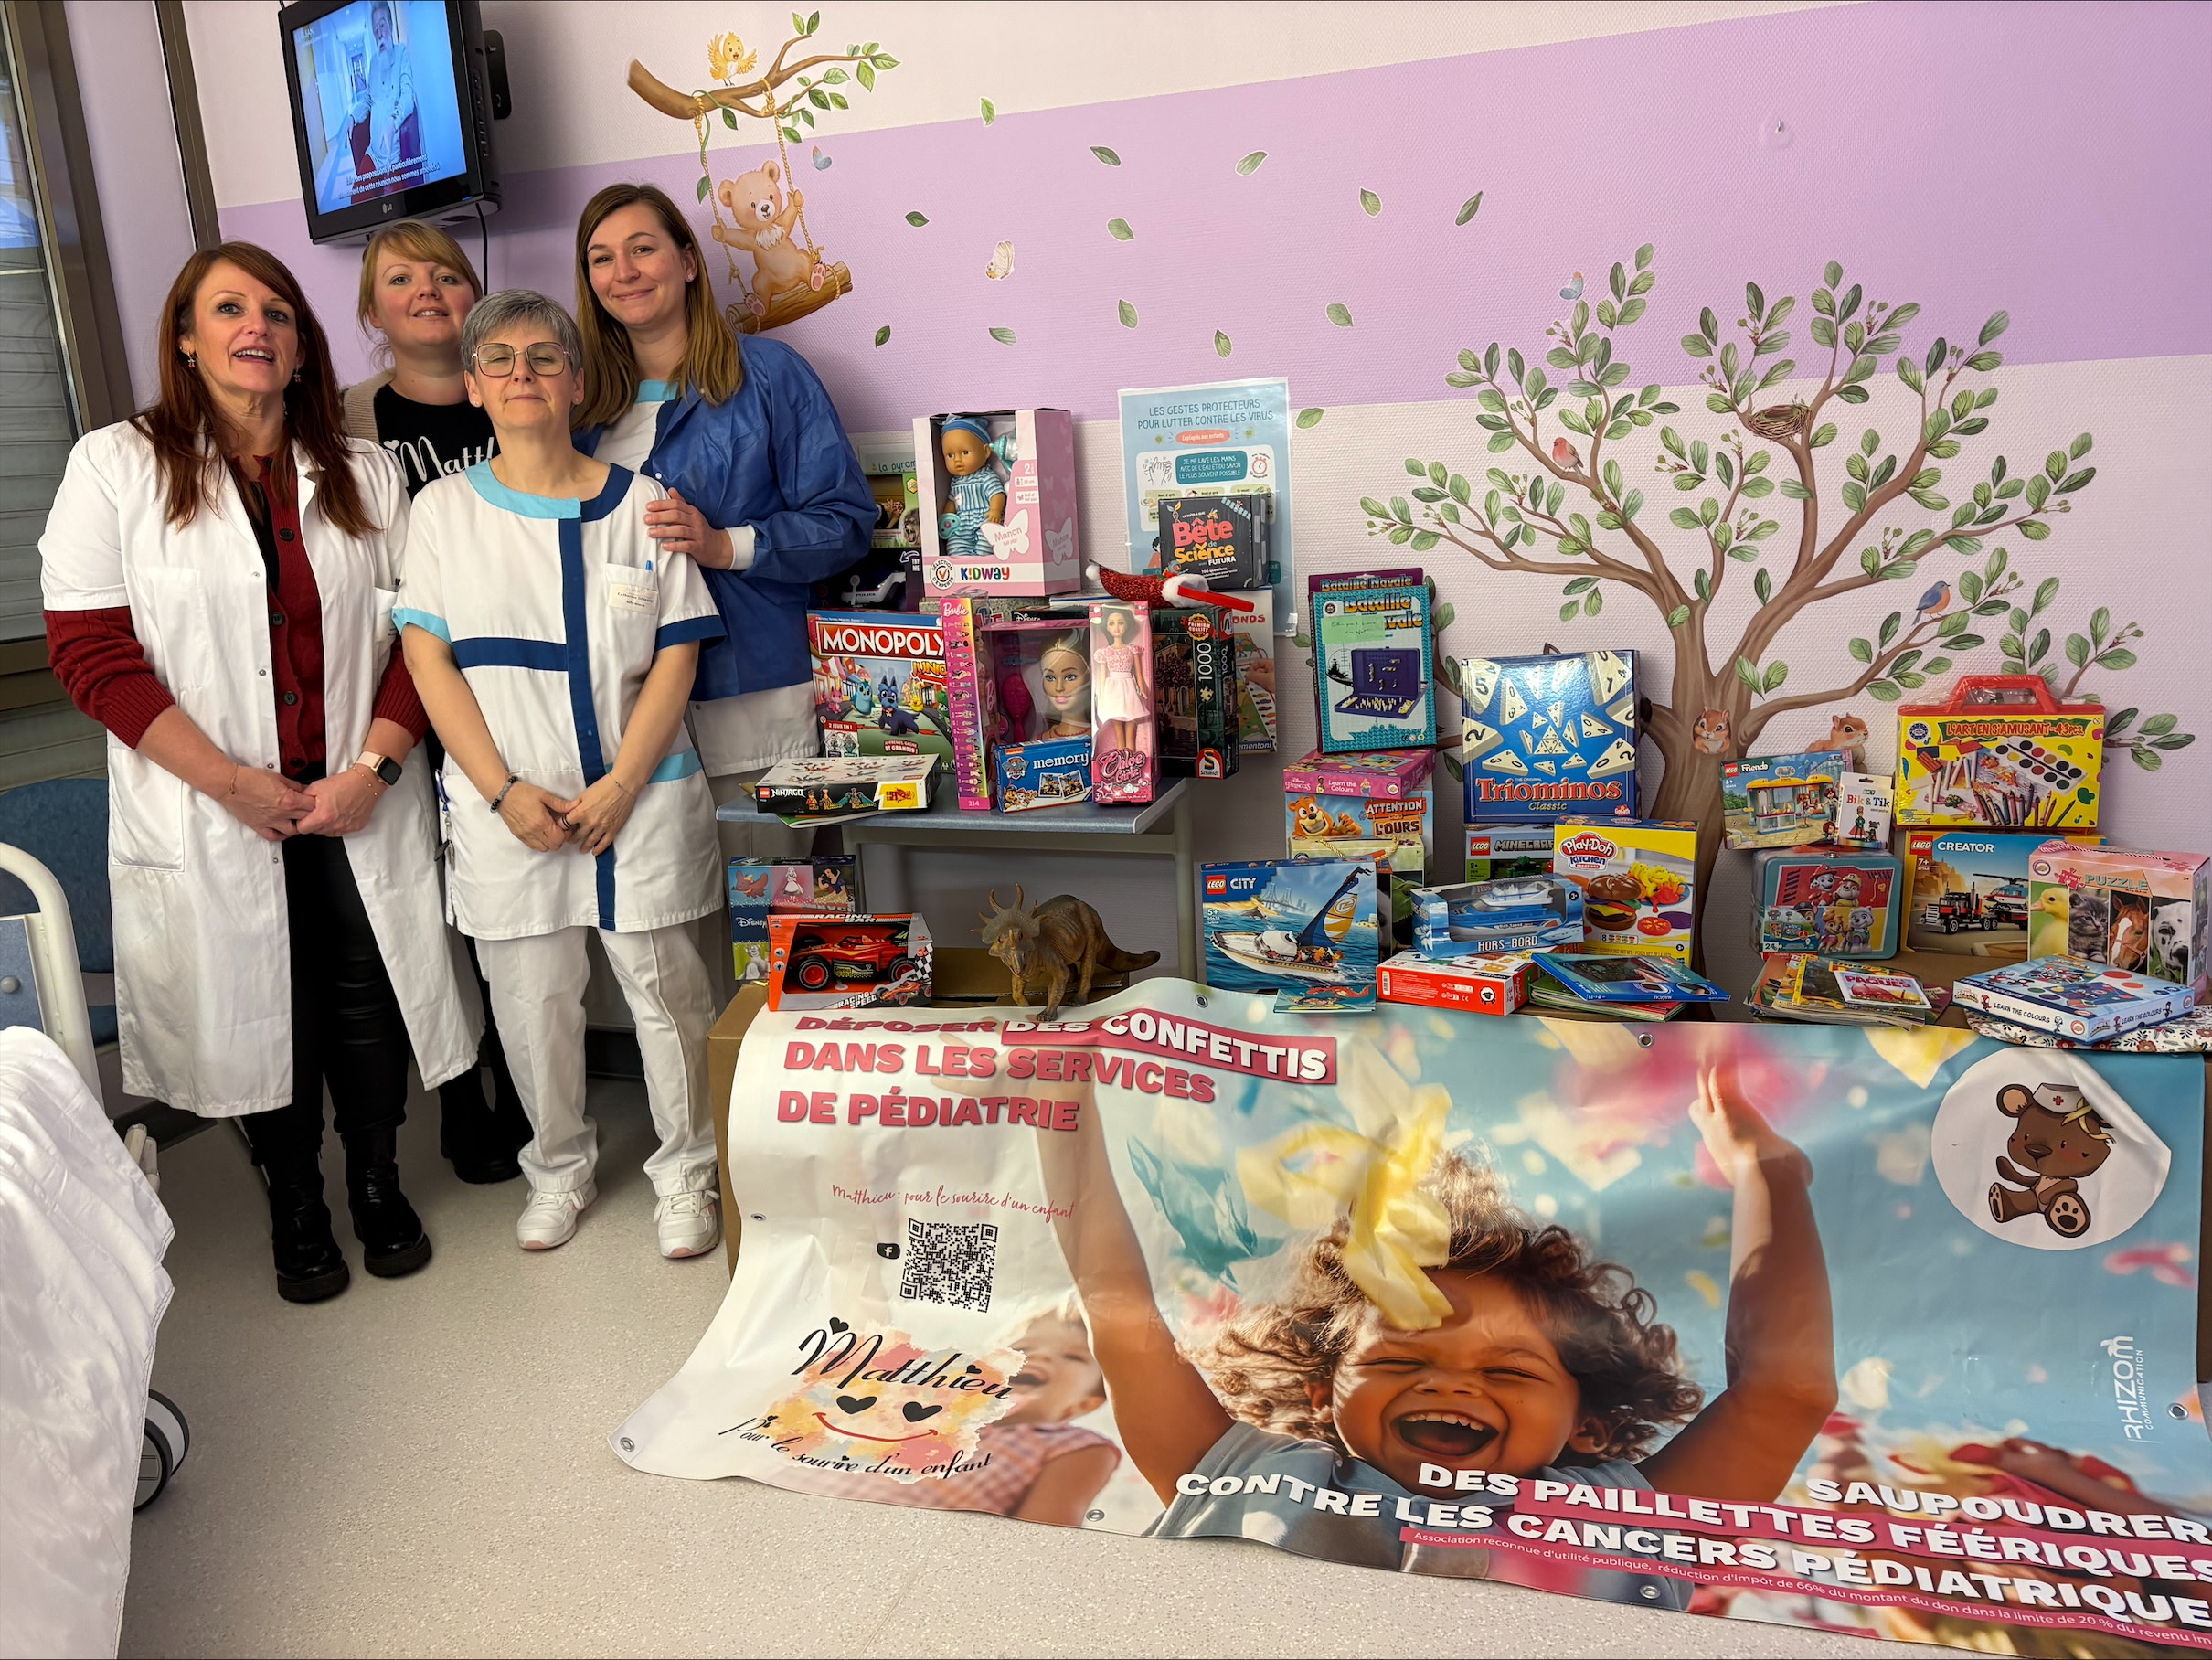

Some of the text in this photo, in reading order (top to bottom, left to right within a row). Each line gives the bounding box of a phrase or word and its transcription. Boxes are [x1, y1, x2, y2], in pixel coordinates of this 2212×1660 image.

[363, 167, 388, 182] propositions
[1149, 399, 1260, 416] LES GESTES PROTECTEURS
[1138, 410, 1273, 430] POUR LUTTER CONTRE LES VIRUS
[384, 436, 494, 487] Matt
[994, 527, 1022, 541] Manon
[1172, 517, 1233, 547] Bête
[932, 559, 952, 571] SÉLECTION
[1208, 556, 1236, 566] FUTURA
[1321, 575, 1413, 591] Bataille Navale
[943, 602, 969, 617] Barbie
[1344, 592, 1411, 613] Bataille
[1232, 614, 1265, 623] ONDS
[1385, 611, 1423, 630] vale
[824, 627, 945, 657] MONOPOLY
[914, 661, 947, 676] JUNIO
[1197, 642, 1213, 682] 1000
[1947, 723, 1974, 736] L'ART
[1977, 723, 1990, 735] EN
[1239, 741, 1271, 750] mentoni
[1033, 750, 1089, 770] memory
[1099, 749, 1144, 777] Chloe
[1741, 761, 1769, 771] Friends
[1116, 768, 1140, 783] Girlz
[771, 789, 806, 797] NINJAGO
[1477, 777, 1622, 802] Triominos
[1367, 801, 1422, 815] ATTENTION
[1528, 802, 1568, 811] Classic
[1847, 794, 1864, 804] Bik
[1873, 797, 1889, 807] Tik
[1376, 821, 1419, 835] L'OURS
[1494, 839, 1554, 851] MINECRAF
[1563, 838, 1613, 856] Play-Doh
[1938, 842, 1994, 852] CREATOR
[1207, 880, 1225, 889] LEGO
[2085, 874, 2148, 890] PUZZLE
[735, 917, 767, 929] Disney
[1478, 936, 1538, 952] HORS-BORD
[838, 992, 877, 1009] RACING SPEED
[1994, 1003, 2011, 1013] LEARN
[2023, 1011, 2050, 1023] COLOURS
[2122, 1016, 2134, 1025] LEARN
[2143, 1007, 2162, 1019] COLOURS
[795, 1012, 1327, 1080] DÉPOSER DES CONFETTIS
[784, 1041, 1215, 1103] DANS LES SERVICES
[777, 1086, 1079, 1130] DE PÉDIATRIE
[904, 1192, 933, 1205] pour
[936, 1185, 949, 1207] le
[952, 1192, 999, 1206] sourire
[1001, 1191, 1030, 1211] d'un
[1032, 1201, 1075, 1223] enfant
[791, 1328, 1011, 1399] Matthieu
[2136, 1349, 2154, 1430] COMMUNICATION
[718, 1416, 992, 1479] Pour le sourire d'un enfant
[1805, 1478, 2212, 1545] SAUPOUDRER
[1418, 1463, 2212, 1583] DES PAILLETTES FÉÉRIQUES
[1176, 1473, 2212, 1627] CONTRE LES CANCERS PÉDIATRIQUE
[1414, 1531, 2189, 1642] Association reconnue d'utilité publique, réduction d'impôt de 66% du montant du don dans la limite de 20 % du revenu
